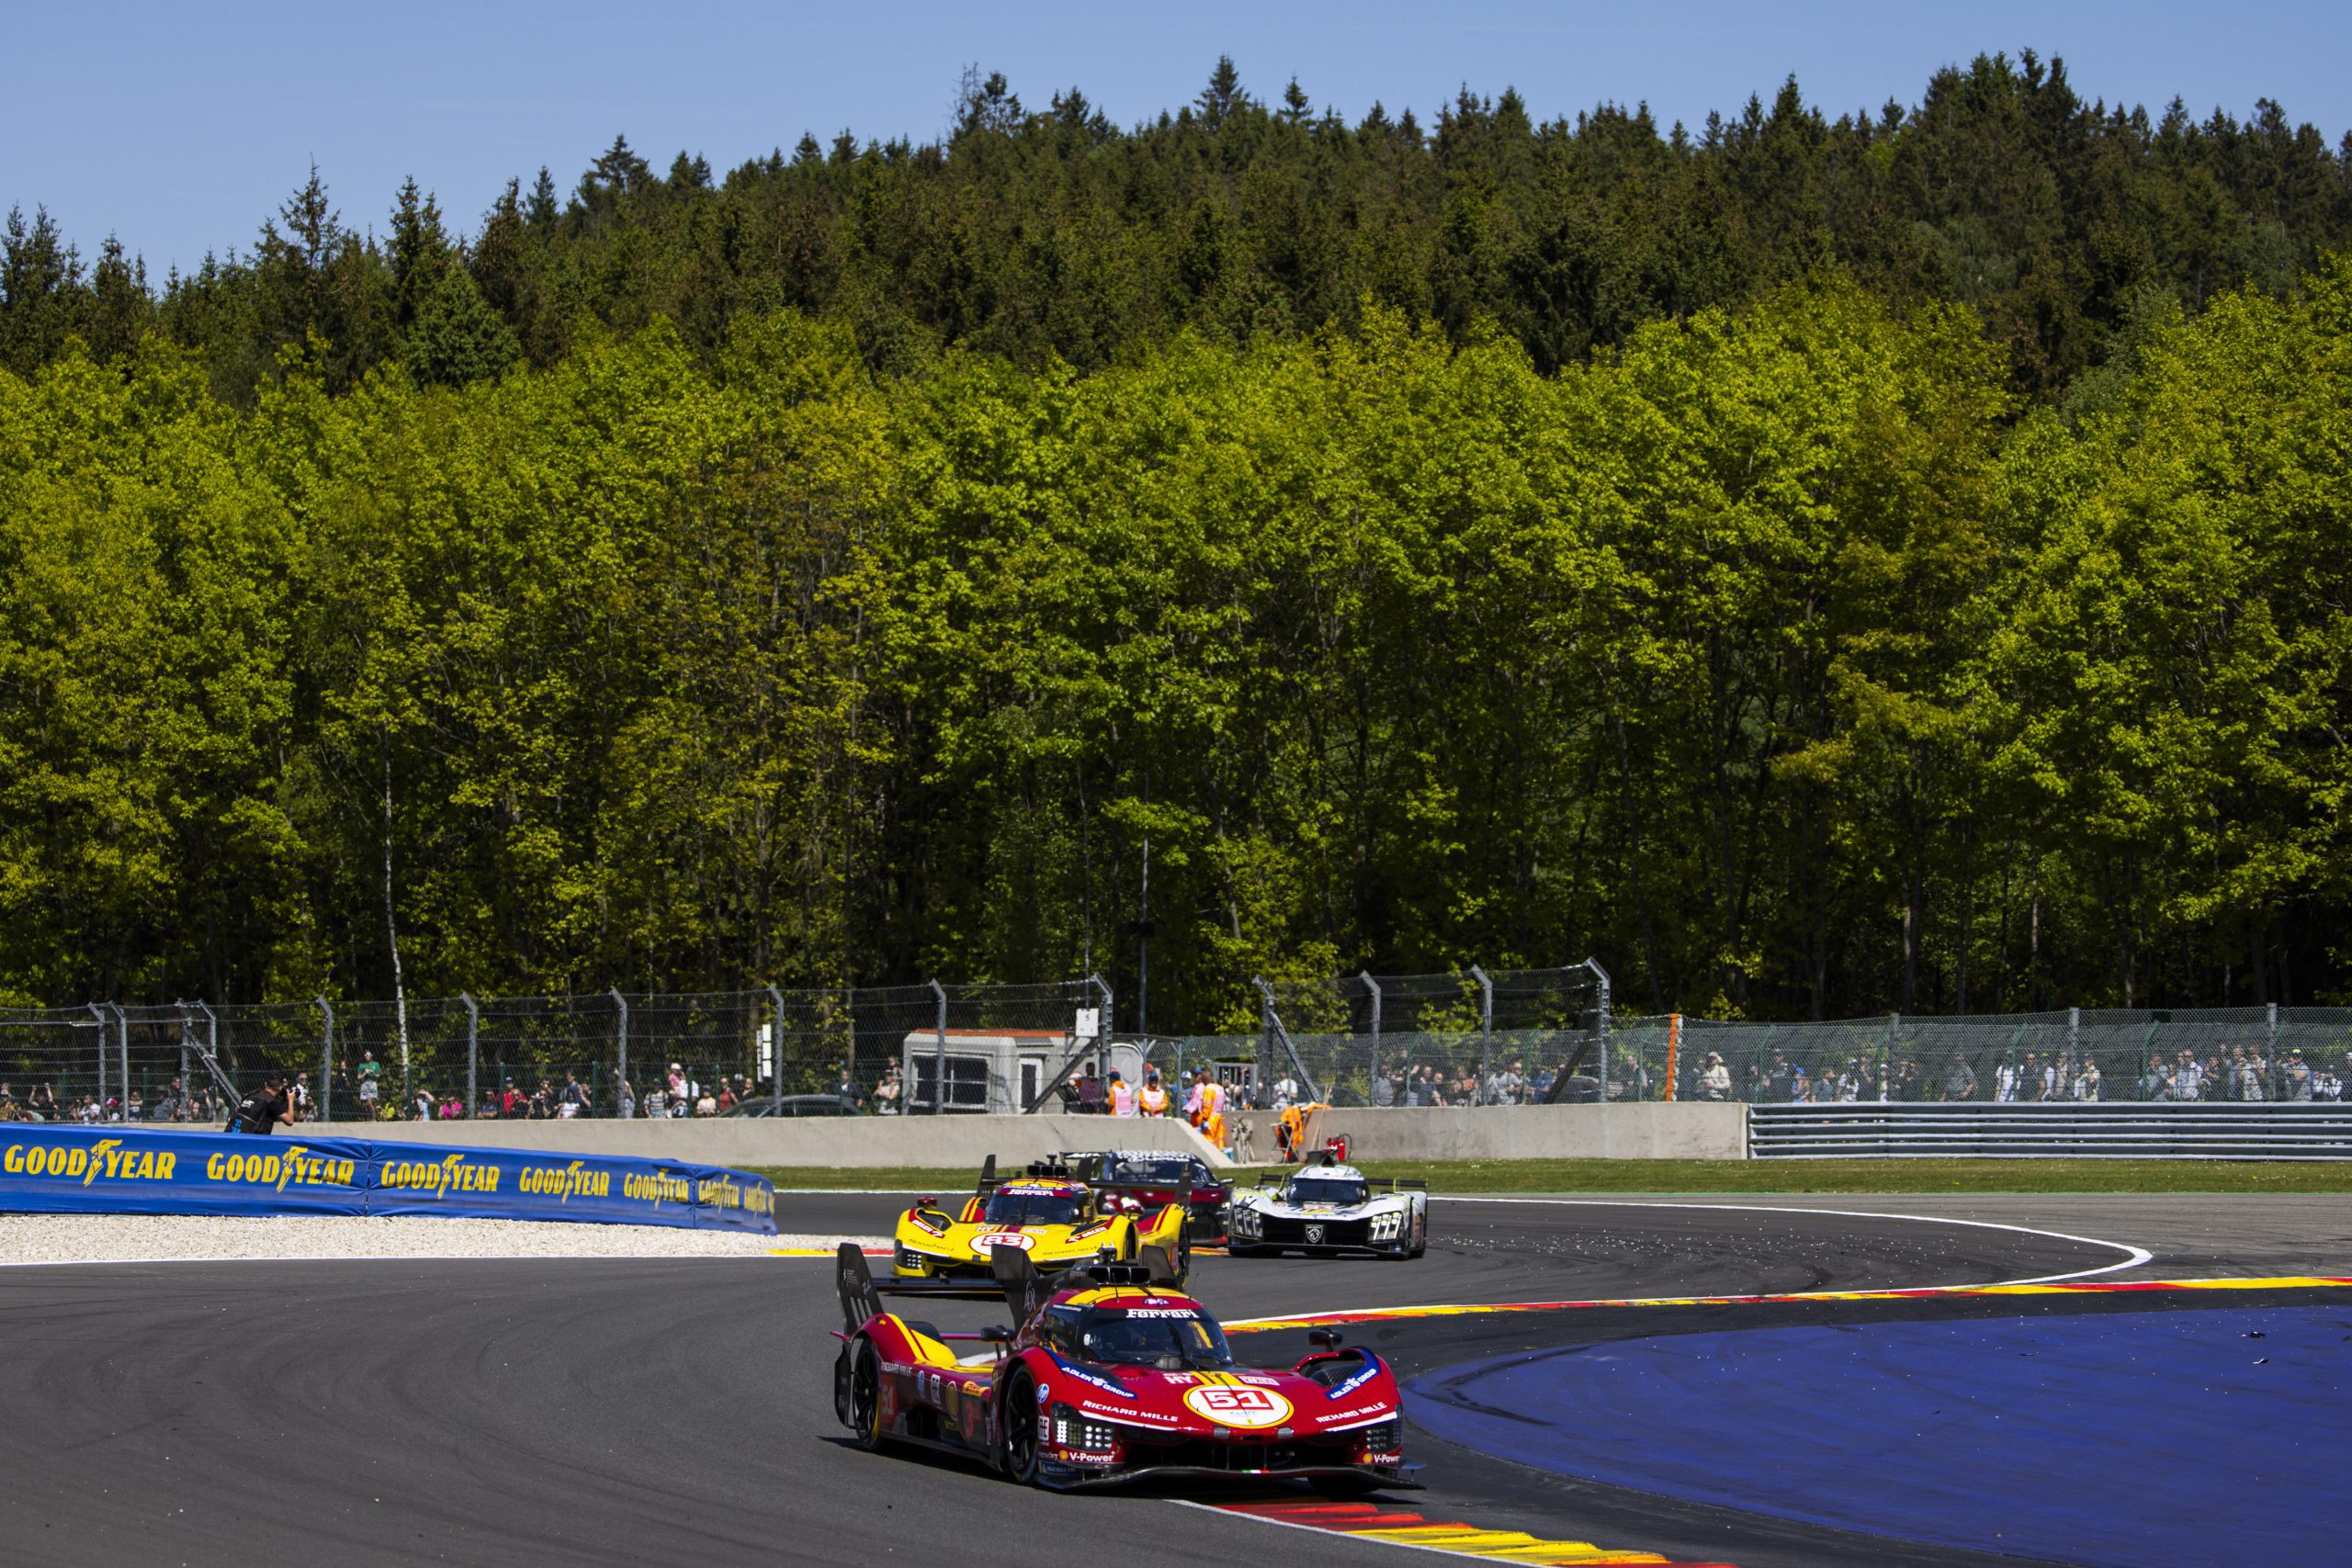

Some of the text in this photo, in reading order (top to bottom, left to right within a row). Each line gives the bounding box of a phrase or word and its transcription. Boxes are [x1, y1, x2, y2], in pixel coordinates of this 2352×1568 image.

[1125, 1309, 1199, 1319] Ferrari
[1061, 1367, 1135, 1399] ADLER GROUP
[1204, 1392, 1270, 1408] 51
[1082, 1400, 1179, 1422] RICHARD MILLE
[1315, 1402, 1387, 1423] RICHARD MILLE
[1069, 1452, 1114, 1462] V-Power
